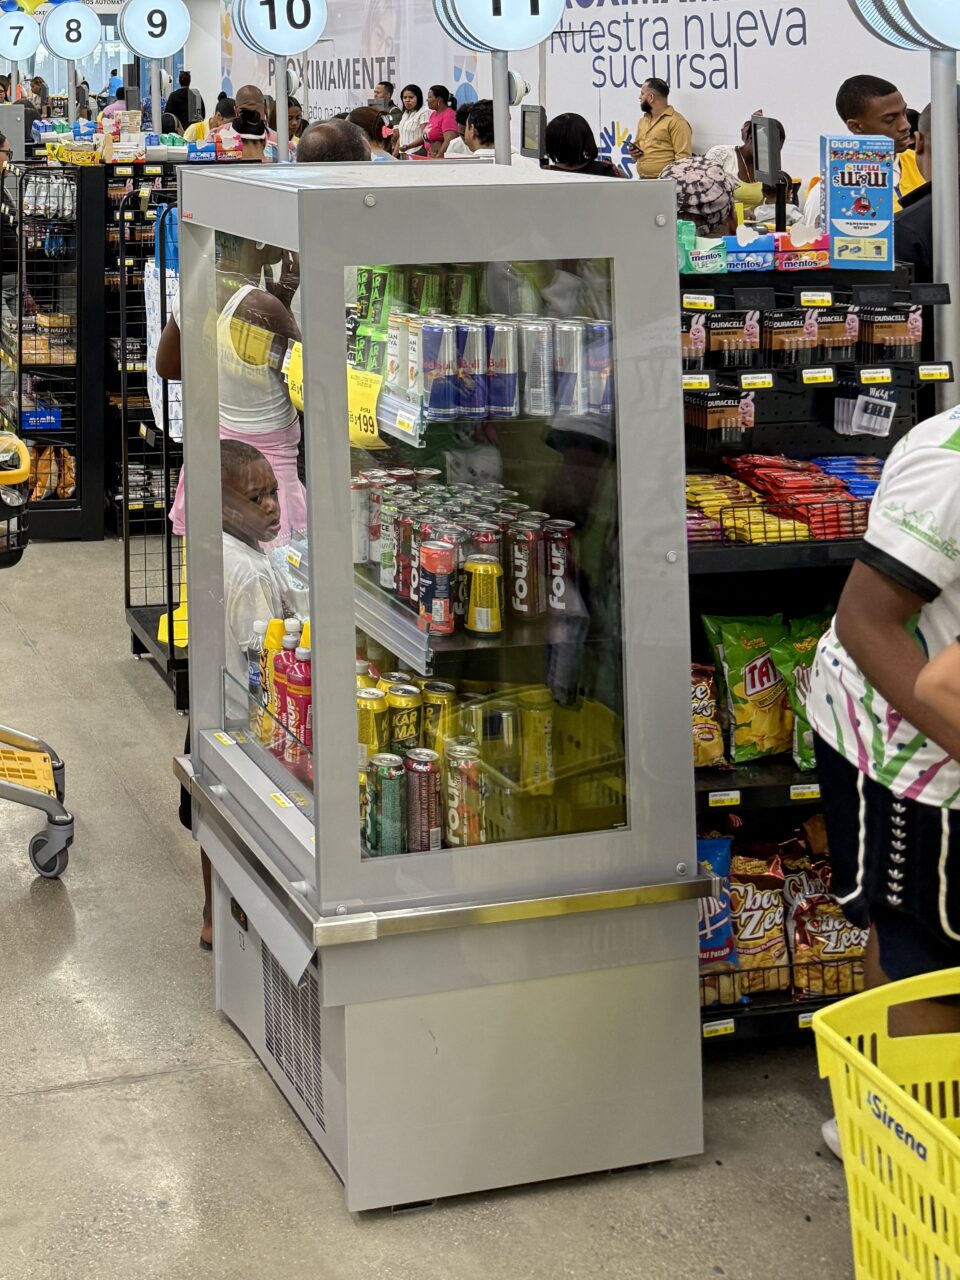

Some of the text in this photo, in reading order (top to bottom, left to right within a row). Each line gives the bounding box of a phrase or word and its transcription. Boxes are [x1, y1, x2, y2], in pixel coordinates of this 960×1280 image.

[65, 18, 82, 43] 8
[147, 9, 168, 39] 9
[550, 6, 807, 54] Nuestra nueva
[10, 25, 24, 47] 7
[268, 56, 397, 91] POXIMAMENTE
[592, 42, 739, 90] sucursal
[691, 250, 722, 262] mentos
[726, 261, 762, 269] mentos
[784, 260, 818, 268] mentos
[711, 320, 744, 329] DURACELL
[773, 320, 804, 328] DURACELL
[707, 399, 739, 407] DURACELL
[392, 710, 418, 727] KAR
[394, 724, 417, 739] MA
[740, 905, 783, 941] Zee
[872, 1094, 927, 1162] Sirena
